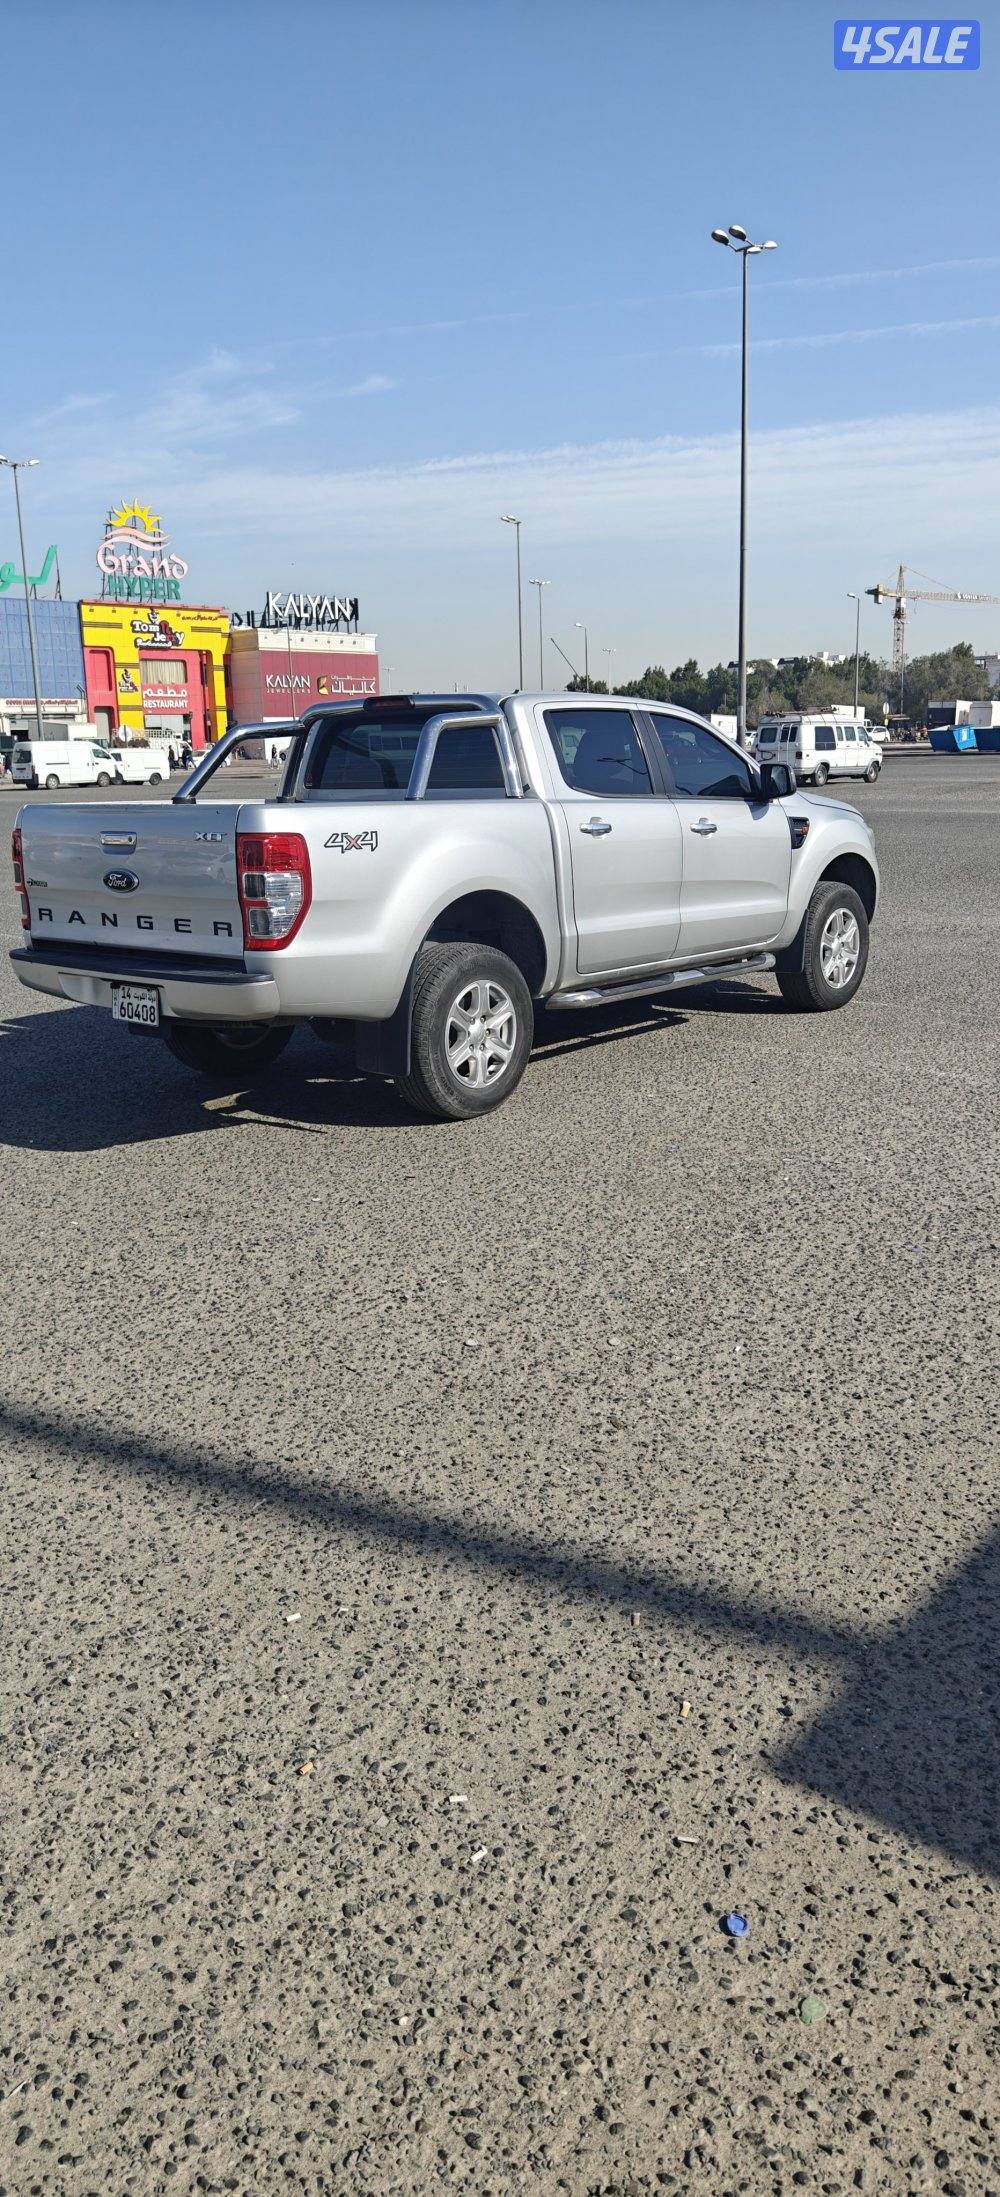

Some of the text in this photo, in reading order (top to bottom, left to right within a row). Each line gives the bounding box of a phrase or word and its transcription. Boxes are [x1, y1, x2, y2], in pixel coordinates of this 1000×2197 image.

[97, 540, 189, 579] Grand
[107, 574, 182, 600] HYPER
[267, 591, 353, 621] KALYAN
[131, 620, 160, 632] Tom
[266, 674, 311, 688] KALYAN
[331, 680, 377, 696] كاليان
[143, 686, 188, 699] مطعم
[143, 700, 189, 708] RESTAURANT
[106, 873, 128, 888] Ford
[37, 907, 234, 938] RANGER
[121, 986, 131, 1000] 14
[120, 1001, 156, 1023] 60408
